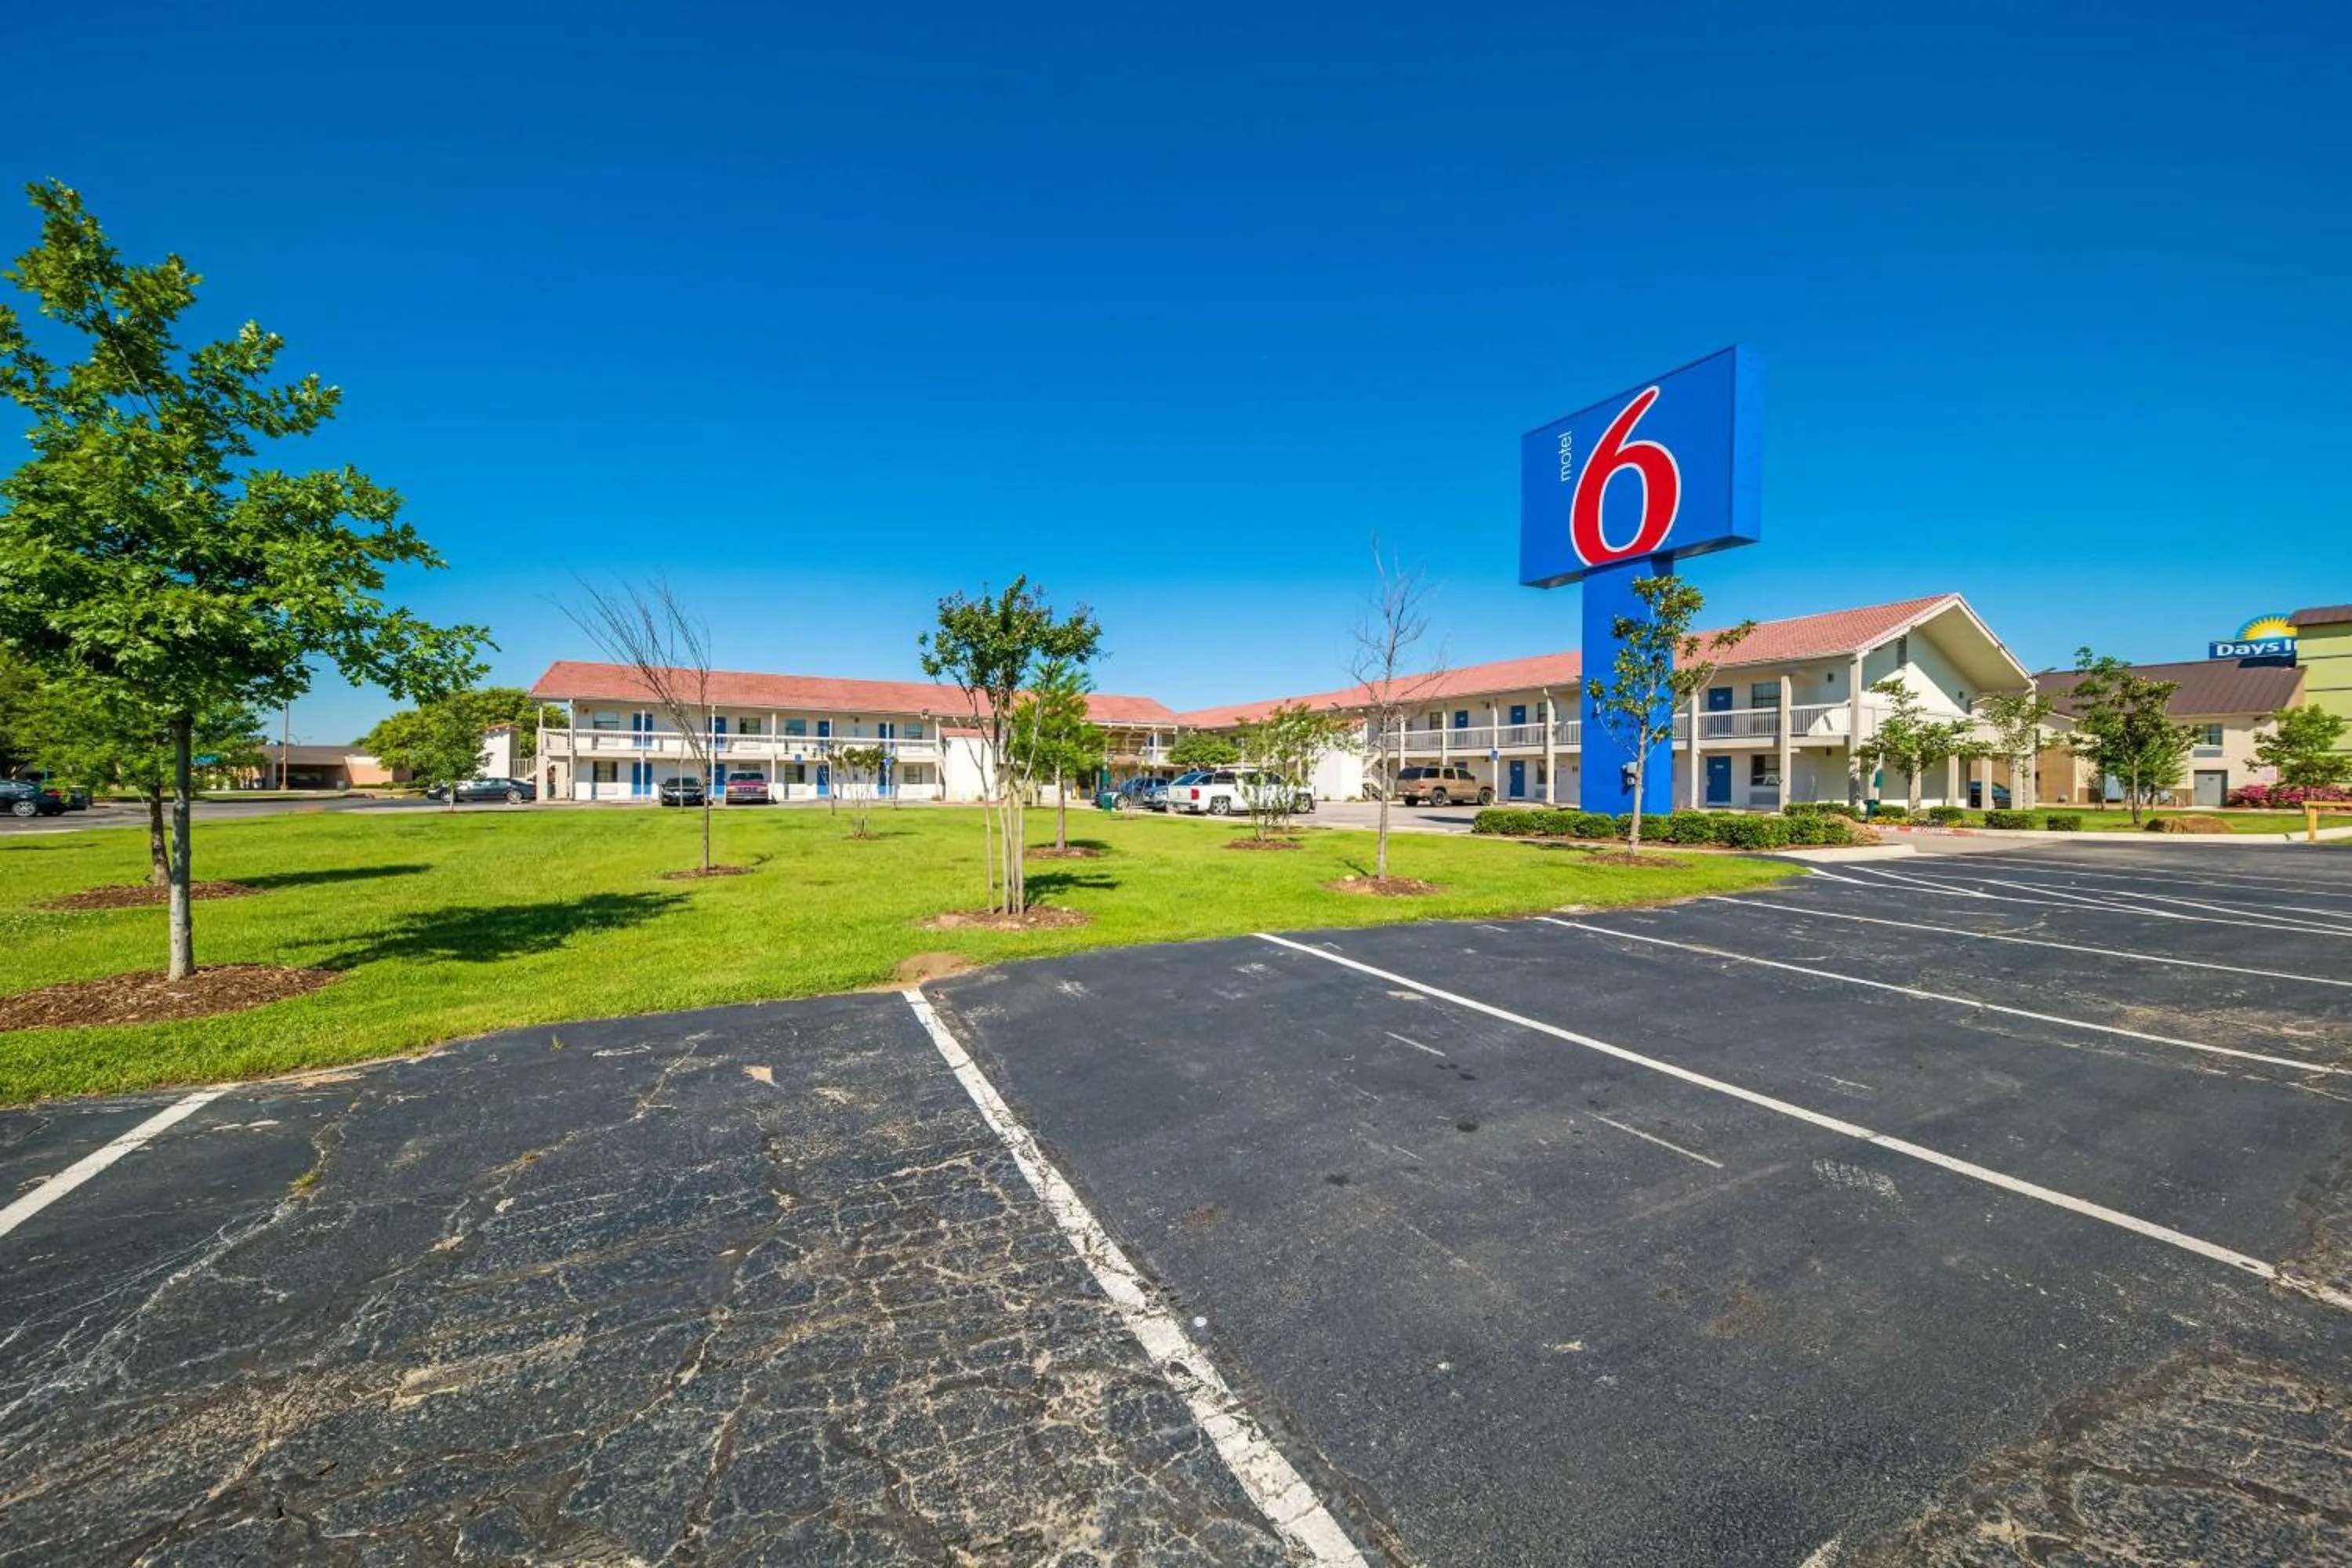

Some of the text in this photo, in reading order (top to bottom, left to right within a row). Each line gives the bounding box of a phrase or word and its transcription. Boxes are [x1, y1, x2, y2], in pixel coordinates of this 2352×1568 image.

[1557, 430, 1573, 483] motel
[1570, 385, 1682, 566] 6
[2216, 641, 2281, 657] Days
